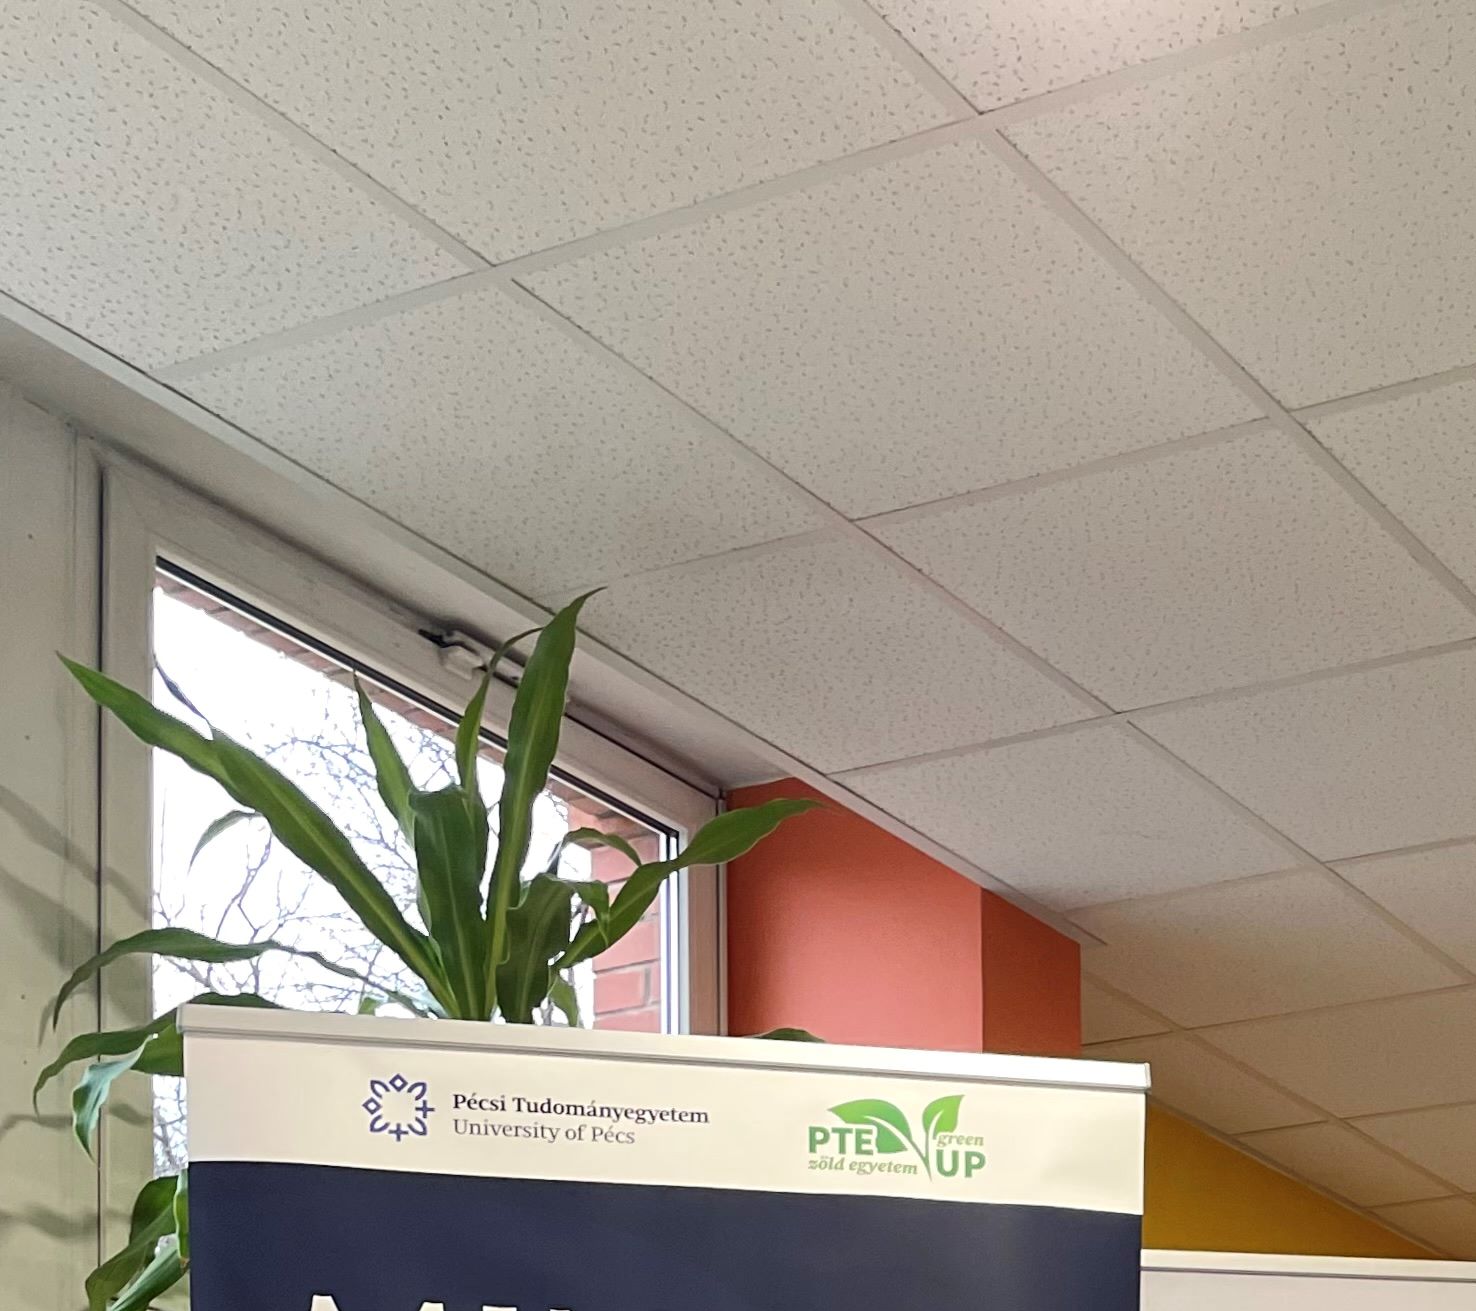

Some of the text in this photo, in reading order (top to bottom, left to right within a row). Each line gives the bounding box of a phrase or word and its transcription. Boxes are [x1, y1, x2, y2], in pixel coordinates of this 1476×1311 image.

[452, 1092, 710, 1125] Pécsi Tudományegyetem
[453, 1118, 636, 1145] University of Pécs
[808, 1126, 874, 1156] PTE
[936, 1133, 985, 1148] green
[808, 1156, 918, 1175] zöld egyetem
[936, 1149, 987, 1178] UP
